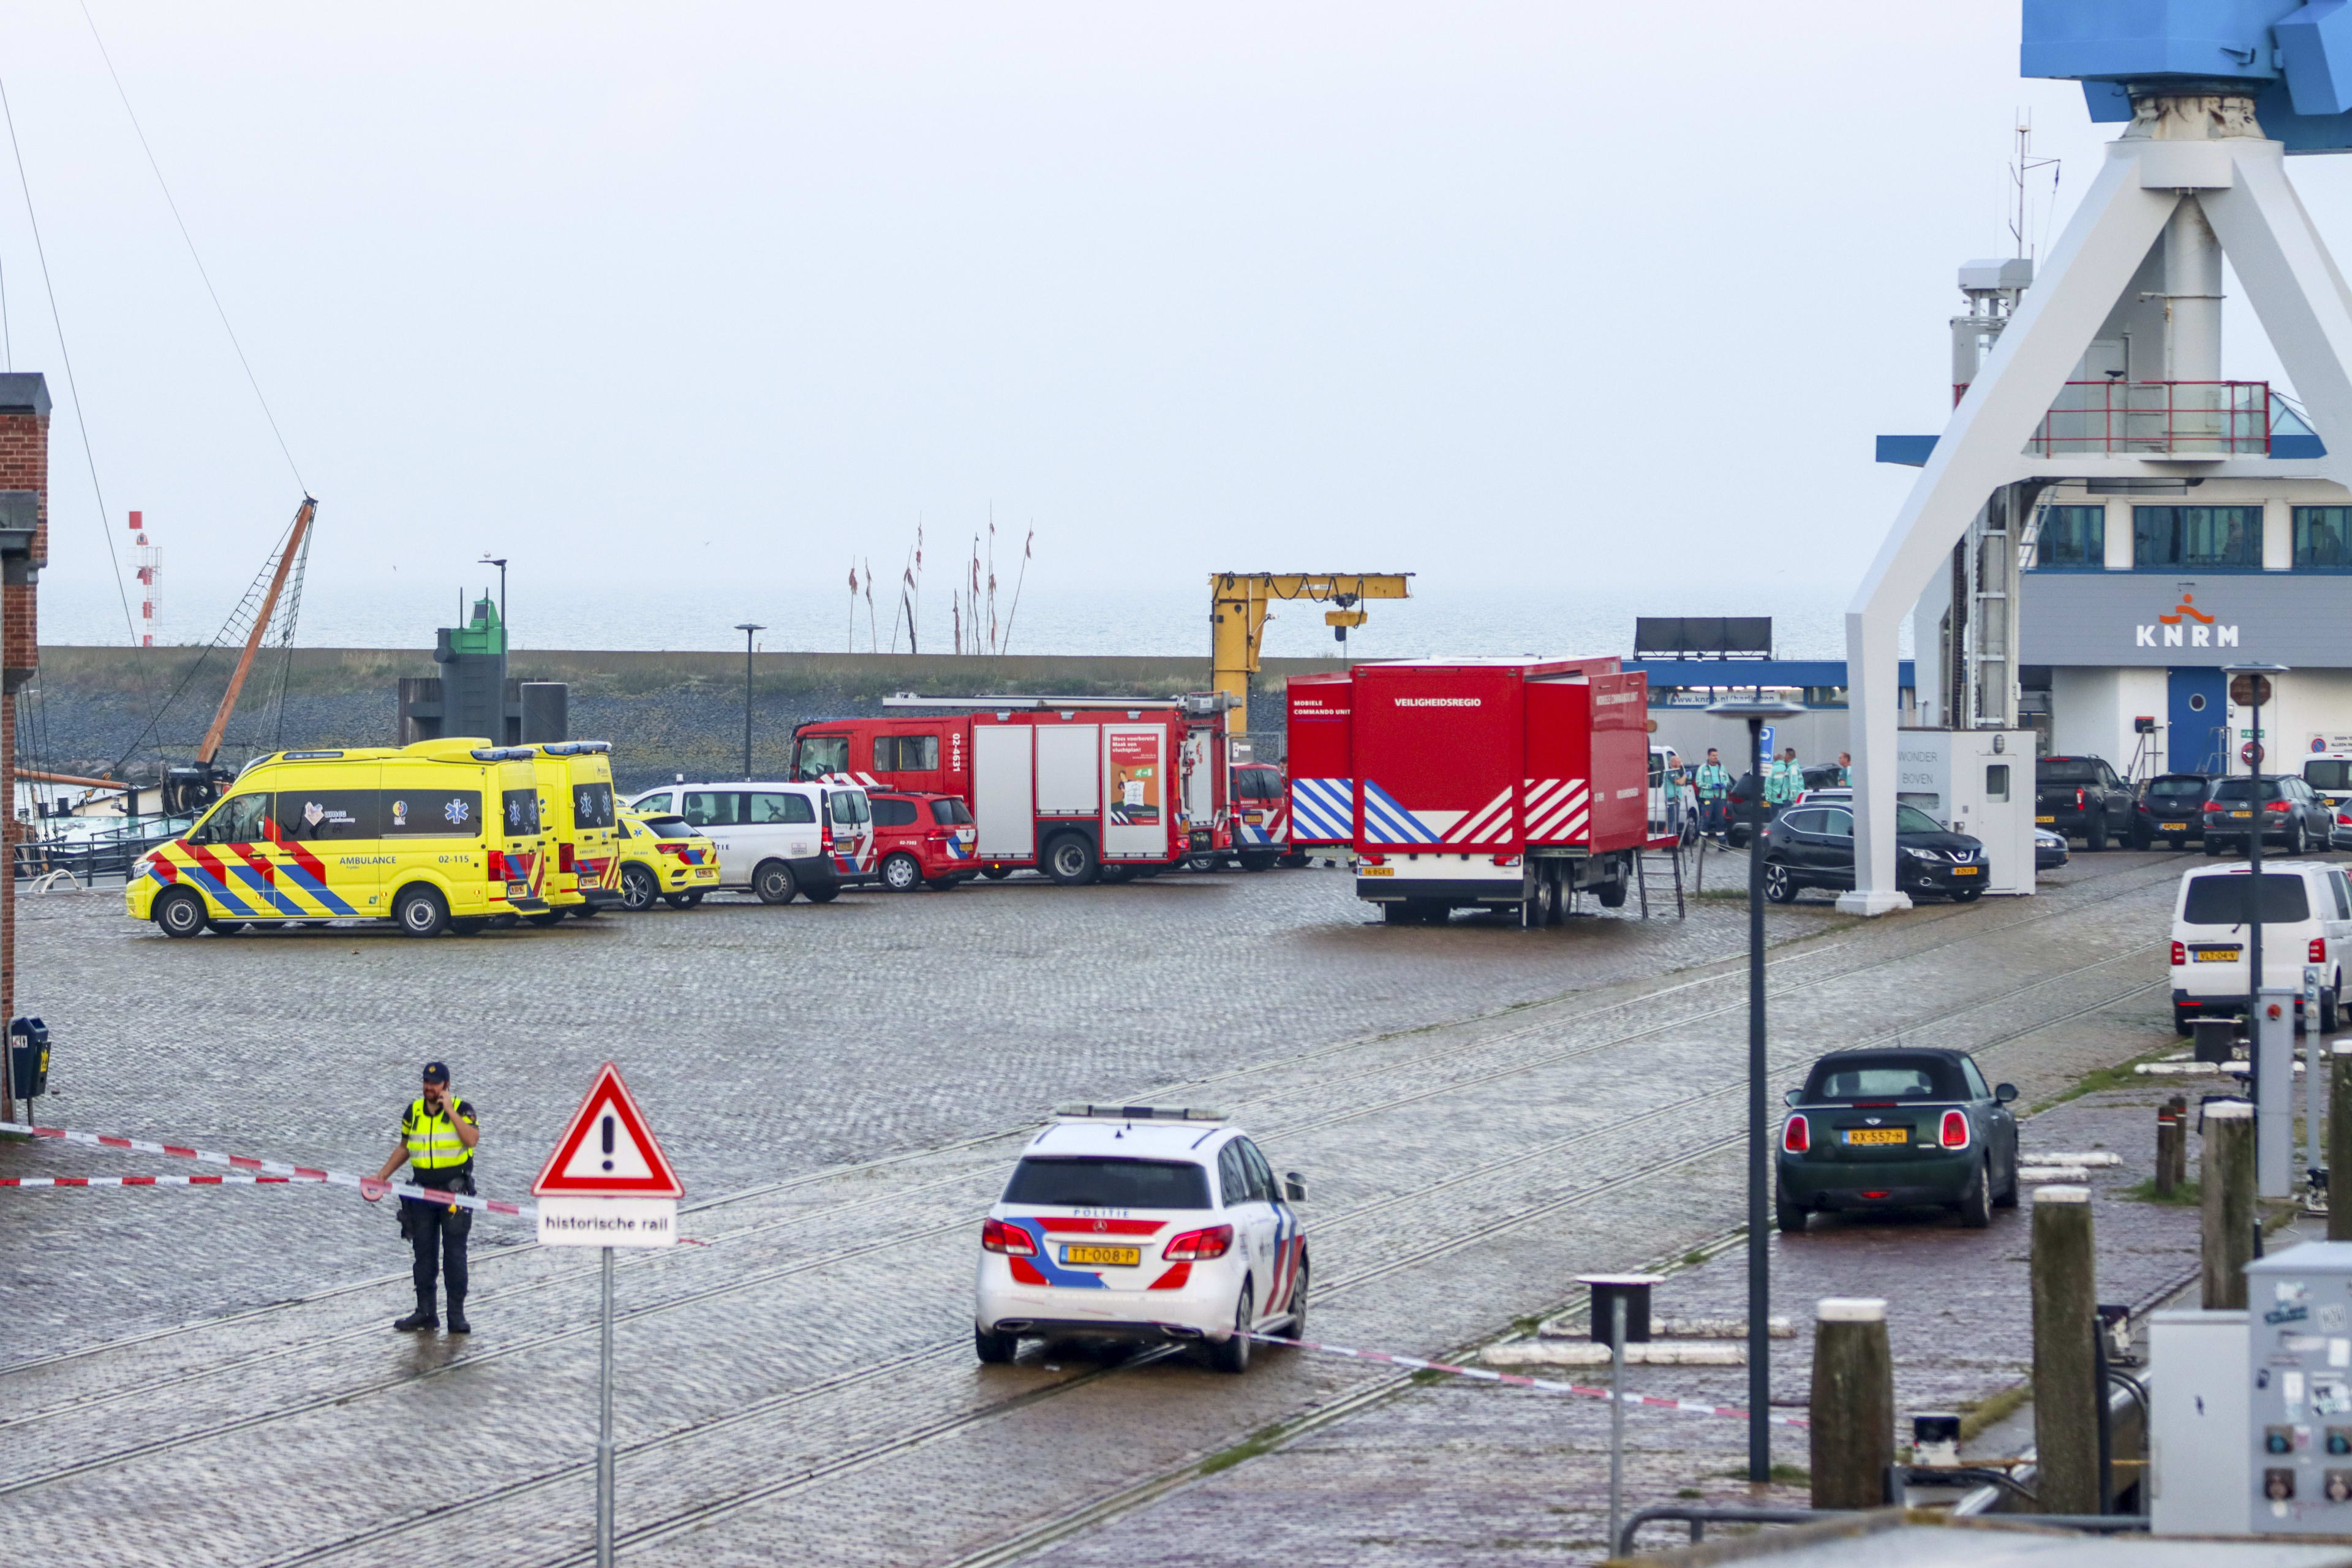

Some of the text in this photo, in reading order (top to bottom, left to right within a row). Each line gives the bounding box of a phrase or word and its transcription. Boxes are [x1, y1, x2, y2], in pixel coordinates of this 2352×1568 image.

[2136, 625, 2239, 647] KNRM
[1898, 751, 1938, 762] WONDER
[1902, 773, 1933, 784] BOVEN
[339, 856, 396, 865] AMBULANCE
[1852, 1131, 1903, 1142] RX-557-H
[1074, 1209, 1129, 1218] POLITIE
[546, 1216, 668, 1231] historische rail
[1072, 1248, 1134, 1262] TT-008-P
